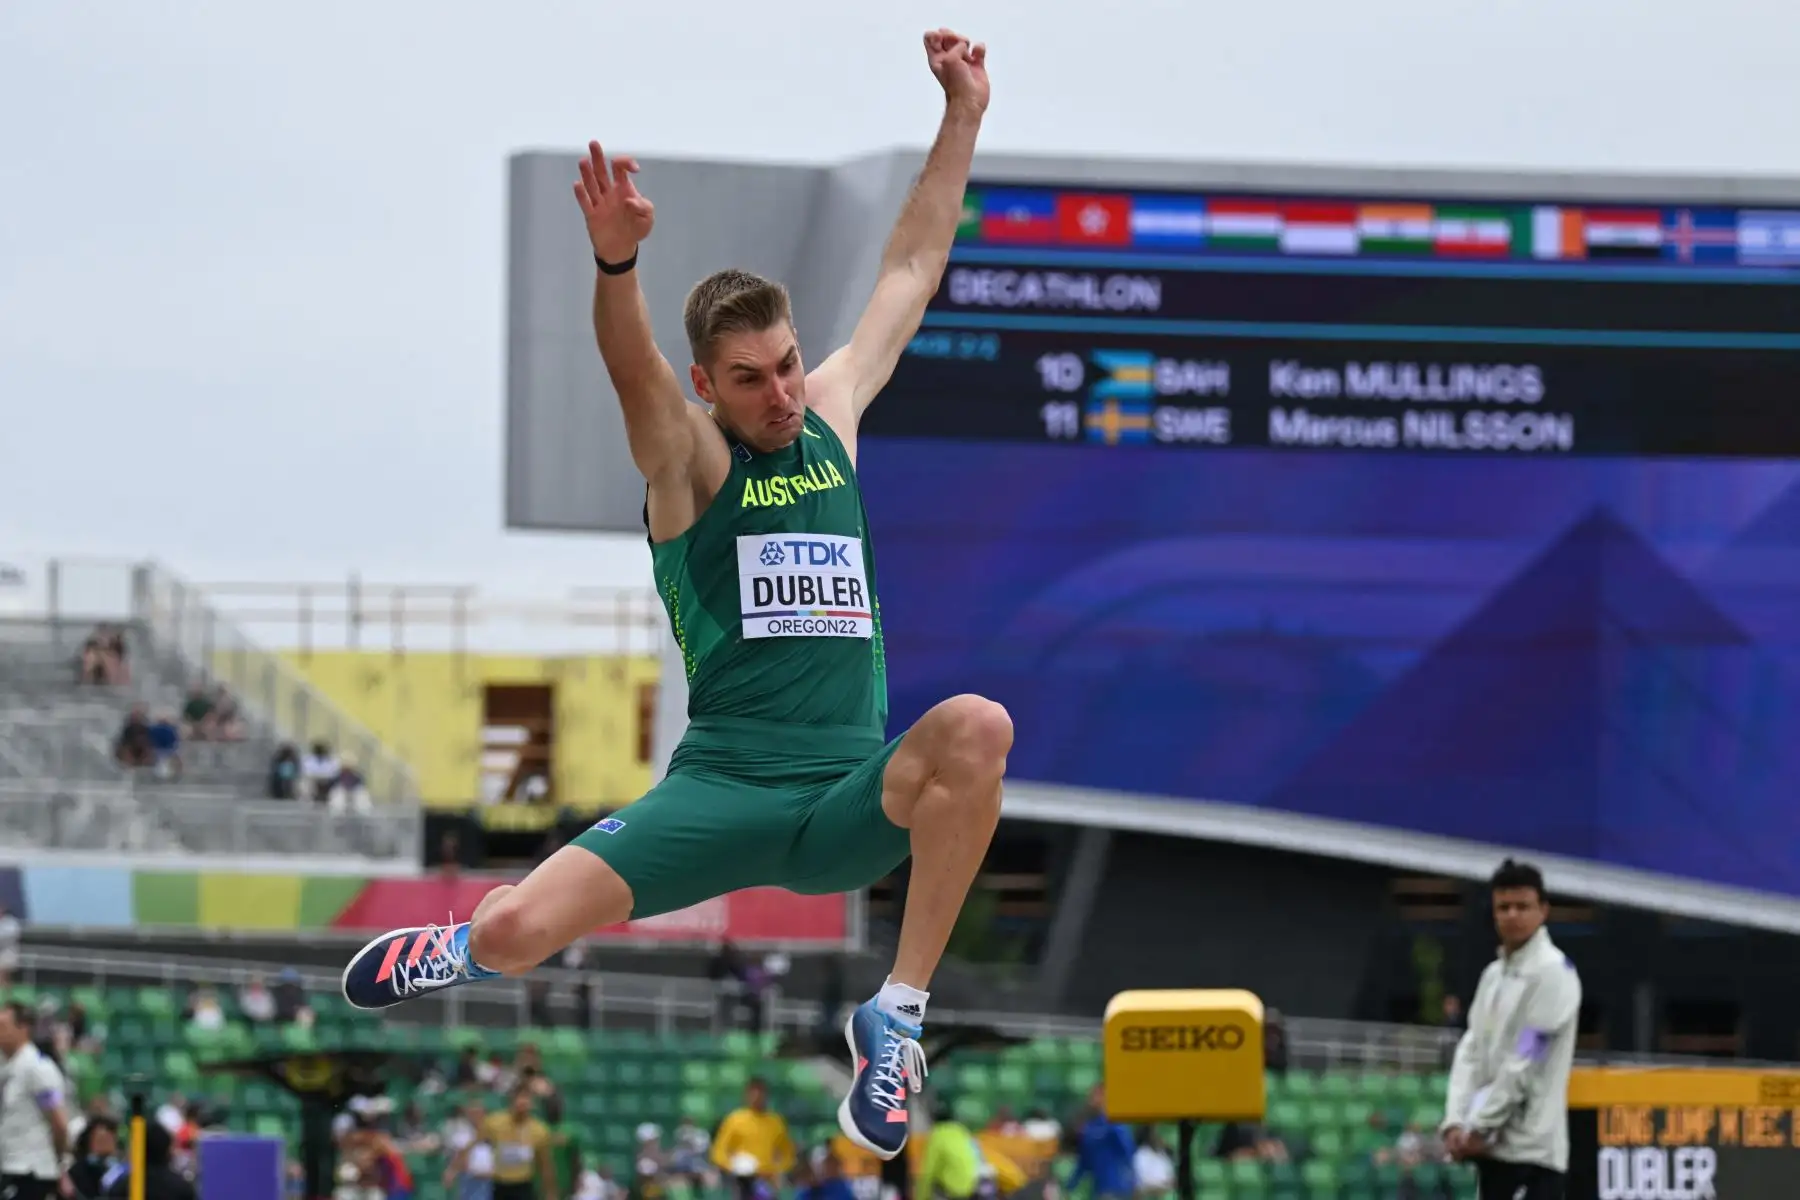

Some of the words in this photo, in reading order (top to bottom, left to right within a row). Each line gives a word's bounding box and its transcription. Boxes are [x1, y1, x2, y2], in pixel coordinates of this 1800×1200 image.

[950, 269, 1161, 311] DECATHLON
[1037, 352, 1084, 392] 10
[1153, 357, 1230, 396] BAH
[1269, 359, 1341, 397] Ken
[1345, 361, 1544, 403] MULLINGS
[1041, 401, 1079, 438] 11
[1153, 406, 1231, 443] SWE
[1269, 406, 1399, 446] Marcus
[1403, 409, 1574, 450] NILSSON
[741, 459, 846, 507] AUSTRALIA
[784, 541, 852, 567] TDK
[752, 575, 864, 608] DUBLER
[767, 619, 858, 634] OREGON22
[1120, 1023, 1245, 1051] SEIKO
[1598, 1146, 1717, 1200] DUBLER
